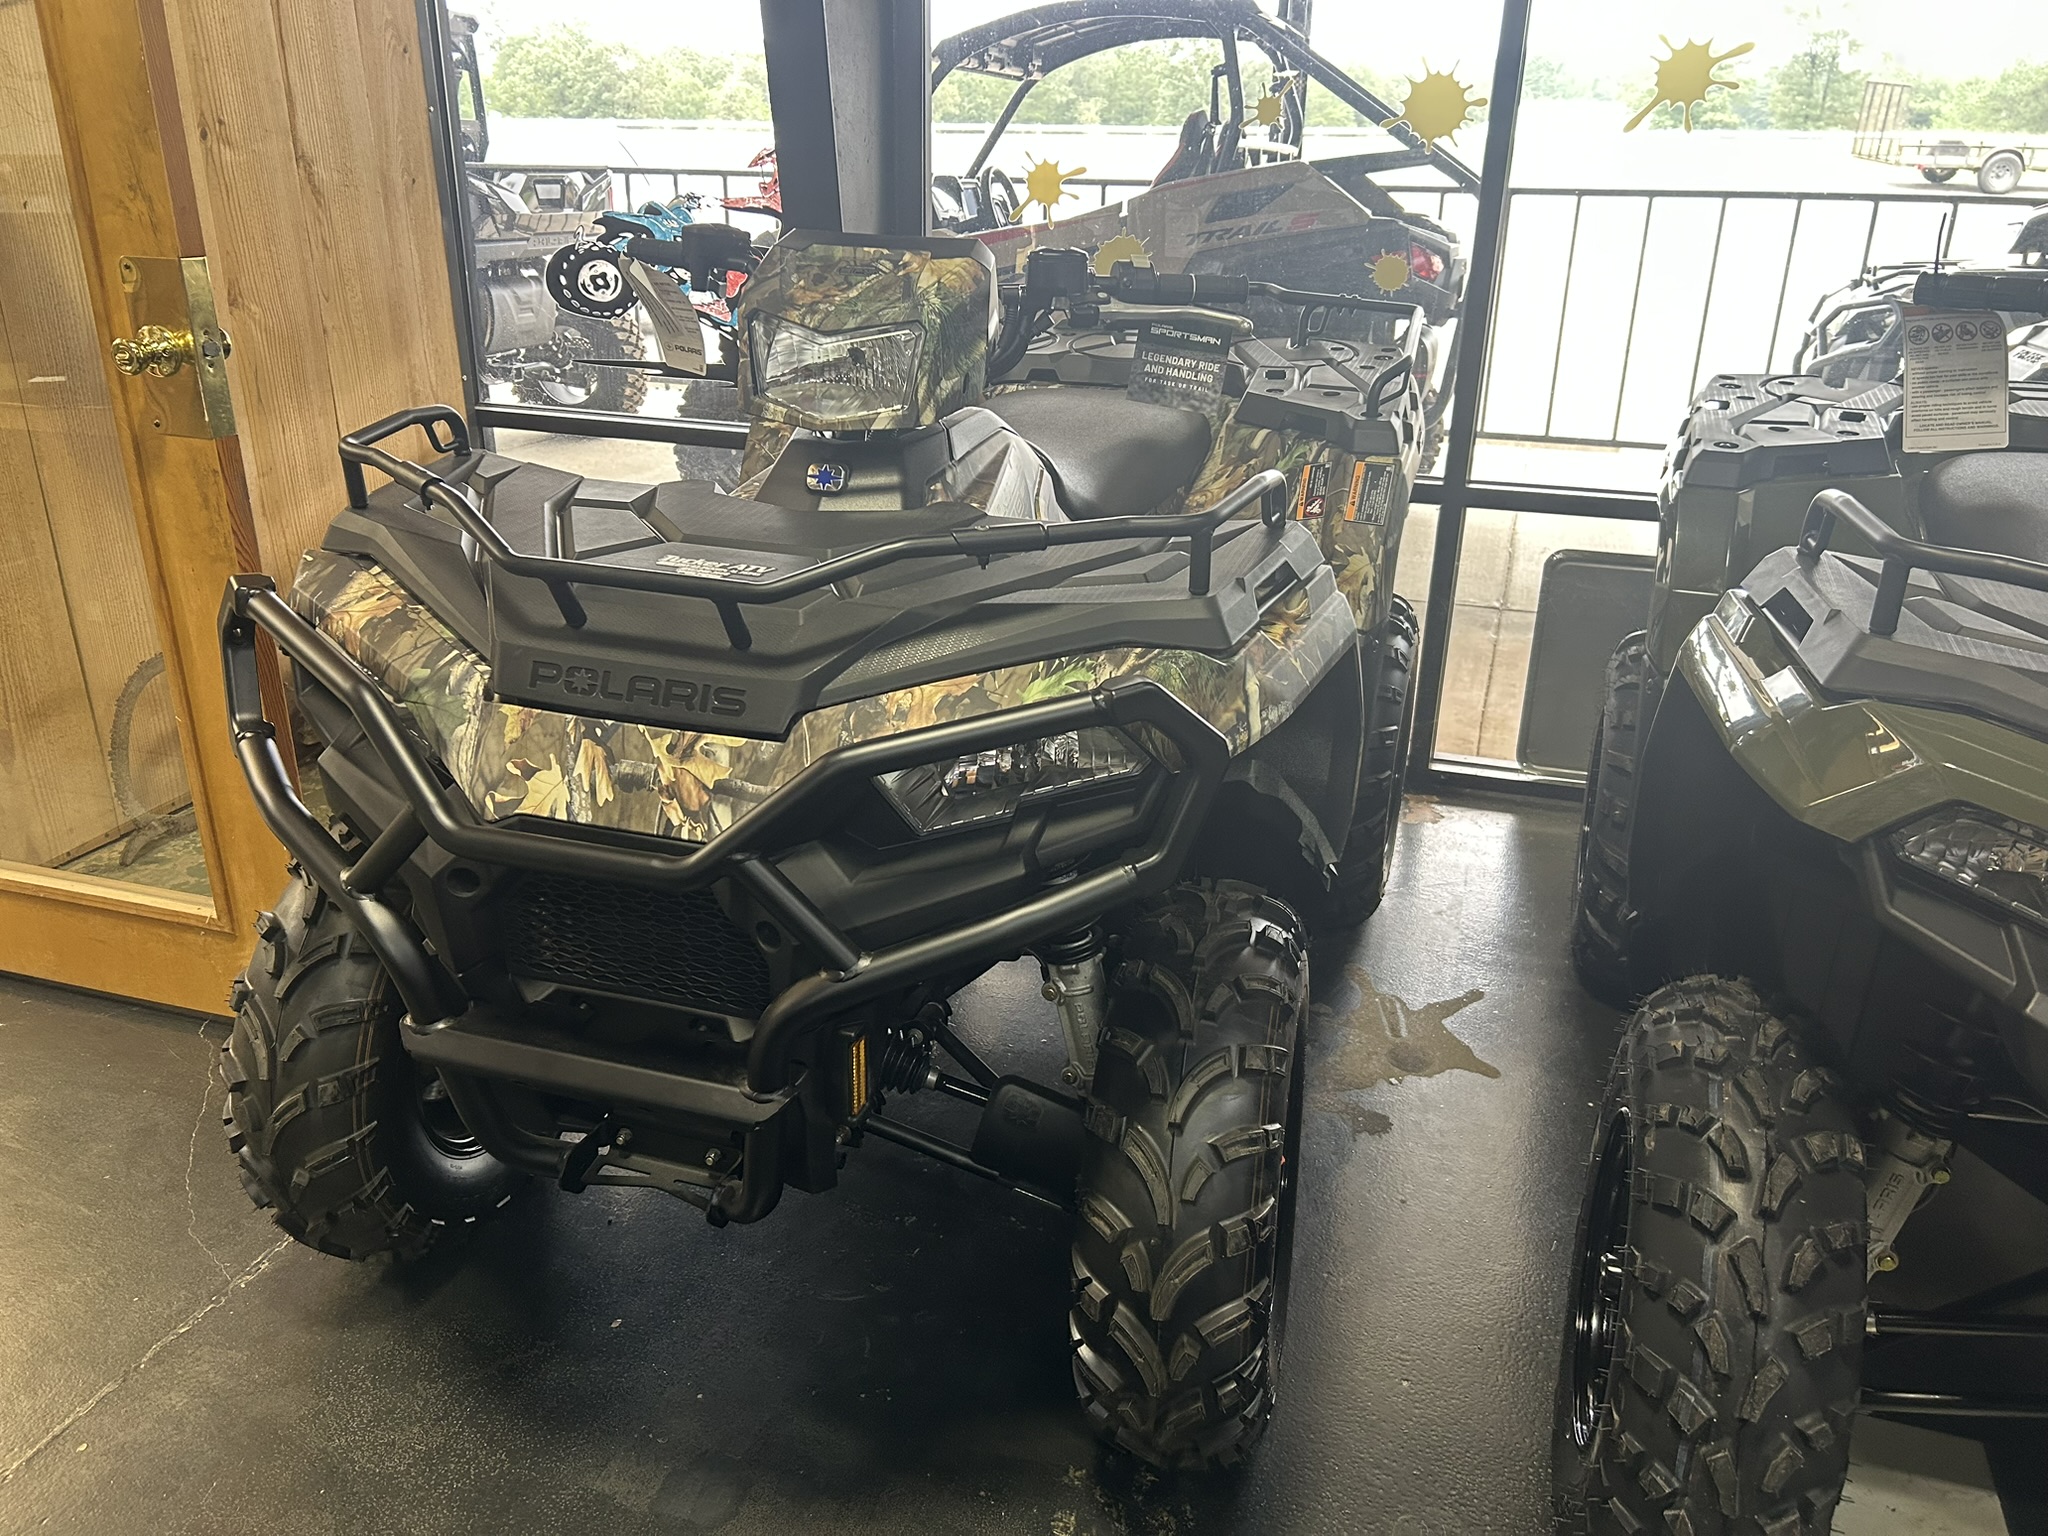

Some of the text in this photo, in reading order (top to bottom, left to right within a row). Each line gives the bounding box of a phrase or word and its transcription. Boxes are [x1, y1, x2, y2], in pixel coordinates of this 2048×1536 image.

[1186, 220, 1284, 246] TRAIL
[1150, 327, 1221, 345] SPORTSMAN
[674, 344, 702, 356] POLARIS
[1142, 351, 1220, 372] LEGENDARY RIDE
[1144, 364, 1213, 383] AND HANDLING
[1190, 385, 1209, 393] TRAIL
[1352, 475, 1360, 500] WARNING
[658, 554, 730, 567] Tucker
[728, 564, 777, 573] ATV
[528, 660, 747, 718] POLARIS
